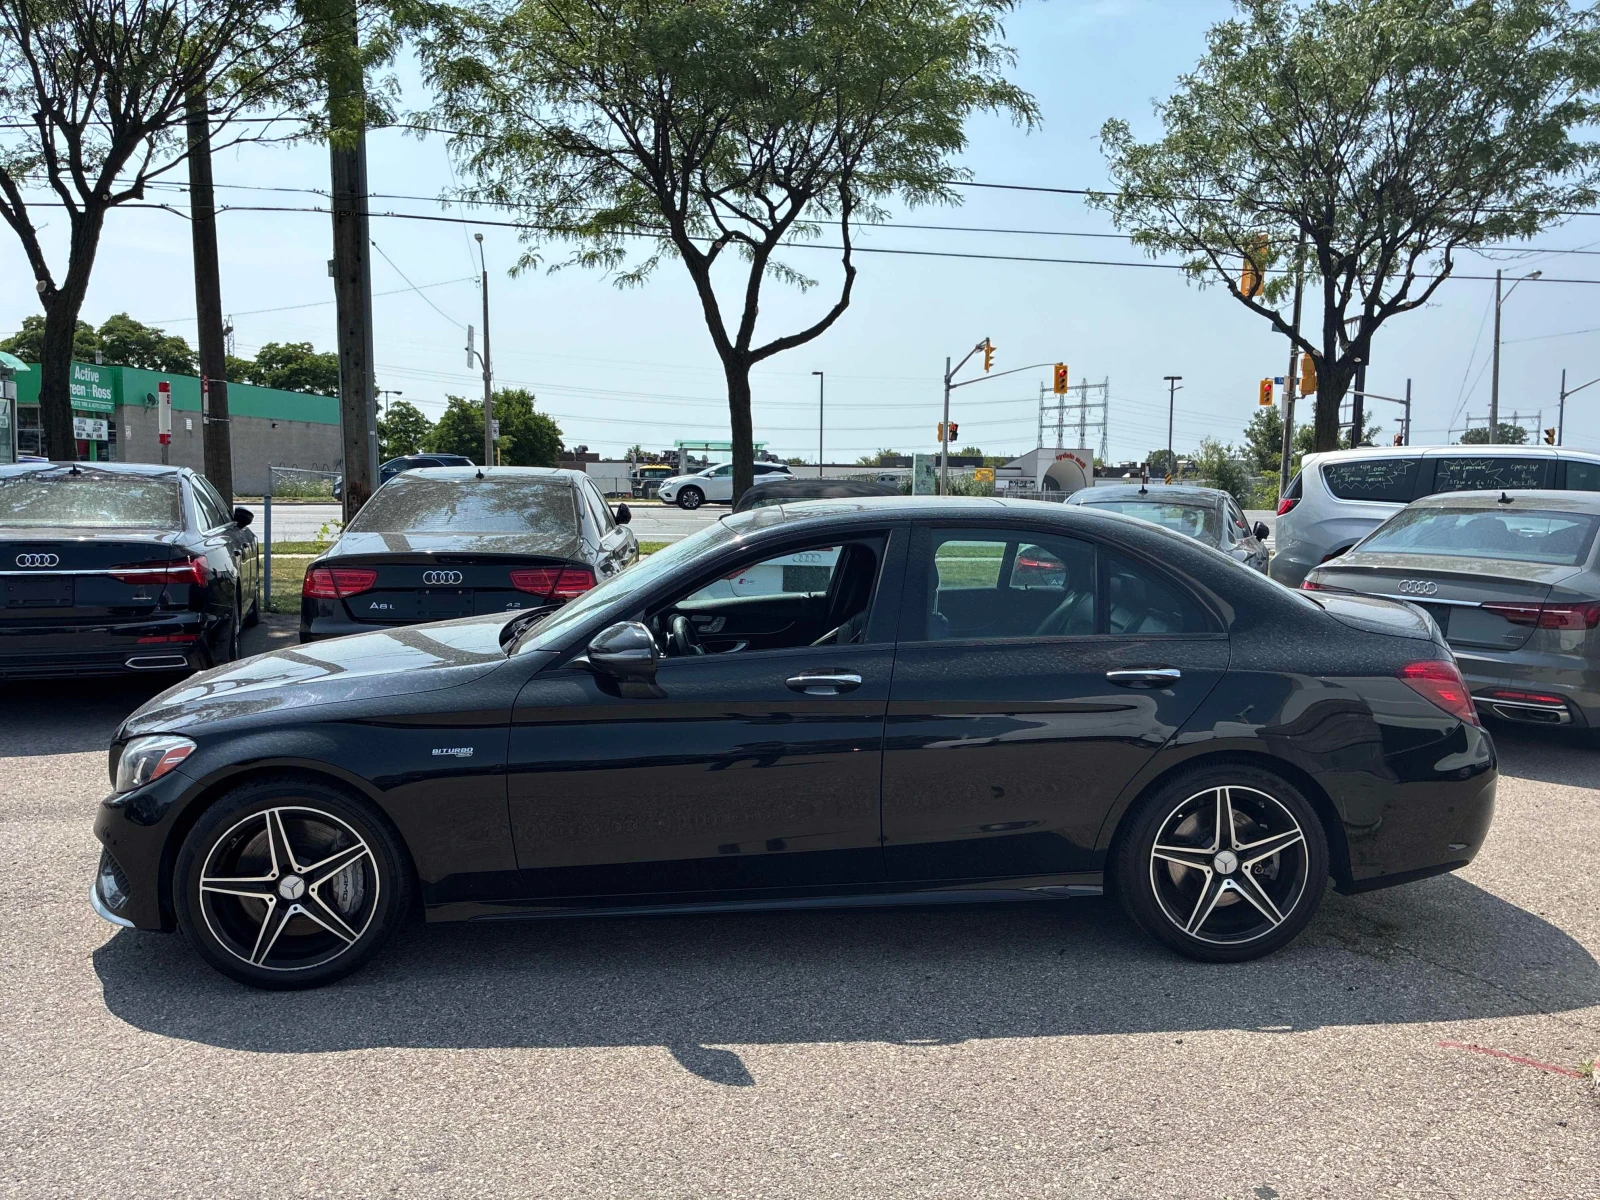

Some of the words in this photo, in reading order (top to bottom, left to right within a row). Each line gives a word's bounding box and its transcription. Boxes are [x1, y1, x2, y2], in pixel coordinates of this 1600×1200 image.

[74, 365, 100, 383] Active
[70, 384, 87, 397] reen
[92, 384, 112, 400] Ross
